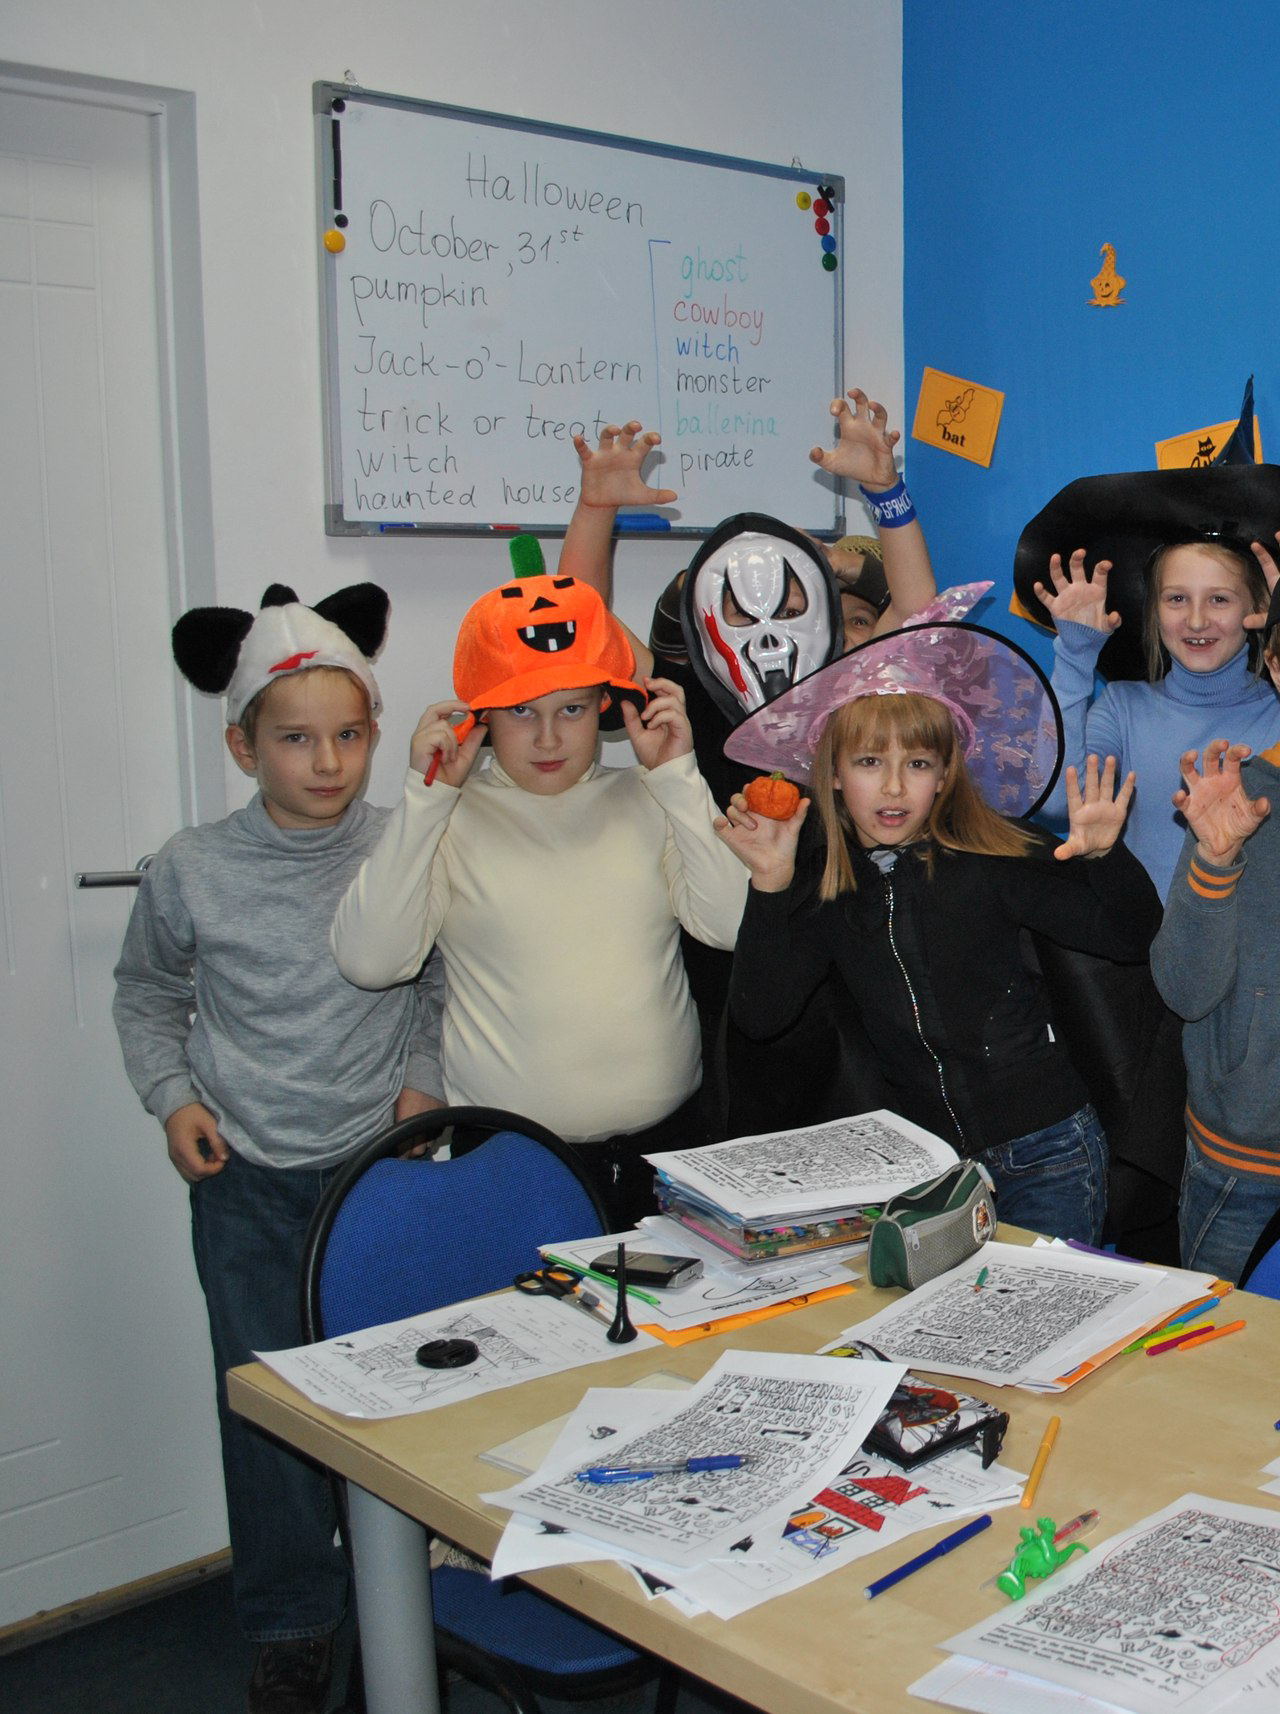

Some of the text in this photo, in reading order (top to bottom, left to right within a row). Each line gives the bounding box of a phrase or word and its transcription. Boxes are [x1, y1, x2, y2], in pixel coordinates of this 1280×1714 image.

[466, 152, 643, 227] Halloween
[681, 244, 748, 298] ghost
[350, 274, 488, 328] pumpkin
[674, 293, 763, 346] cowboy
[677, 333, 740, 364] witch
[677, 367, 771, 394] monster
[358, 388, 608, 442] trick or treat
[676, 400, 779, 436] ballerina
[940, 425, 966, 448] bat
[357, 443, 458, 477] witch
[680, 444, 754, 487] pirate
[354, 477, 575, 510] haunted house
